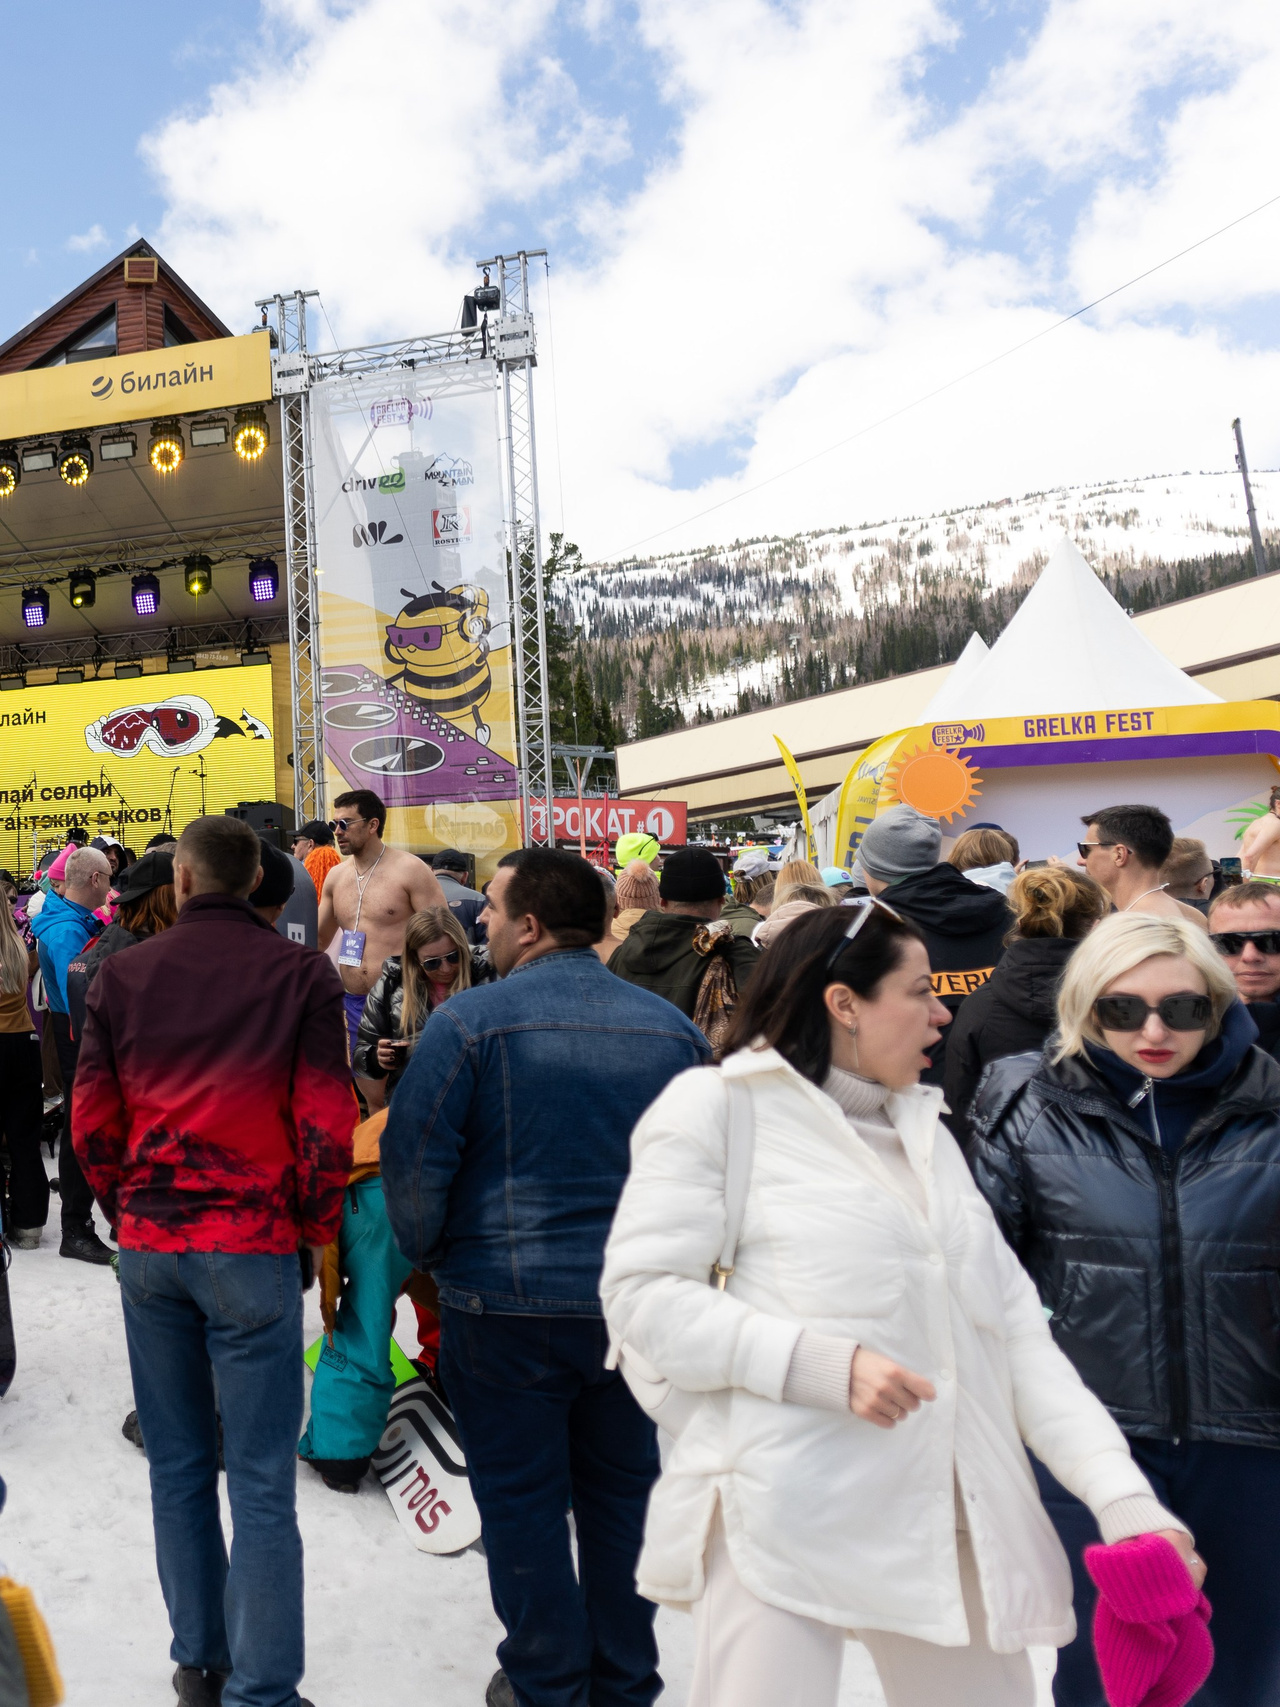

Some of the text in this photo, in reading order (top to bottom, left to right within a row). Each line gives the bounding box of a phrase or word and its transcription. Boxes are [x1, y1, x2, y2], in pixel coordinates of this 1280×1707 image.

[120, 361, 214, 395] билайн
[424, 467, 473, 481] MOUNTAIN
[936, 726, 963, 736] GRELKA
[1023, 711, 1155, 738] GRELKA FEST
[937, 735, 955, 744] FEST
[40, 780, 113, 803] селфи
[529, 805, 636, 837] ПРОКАТ
